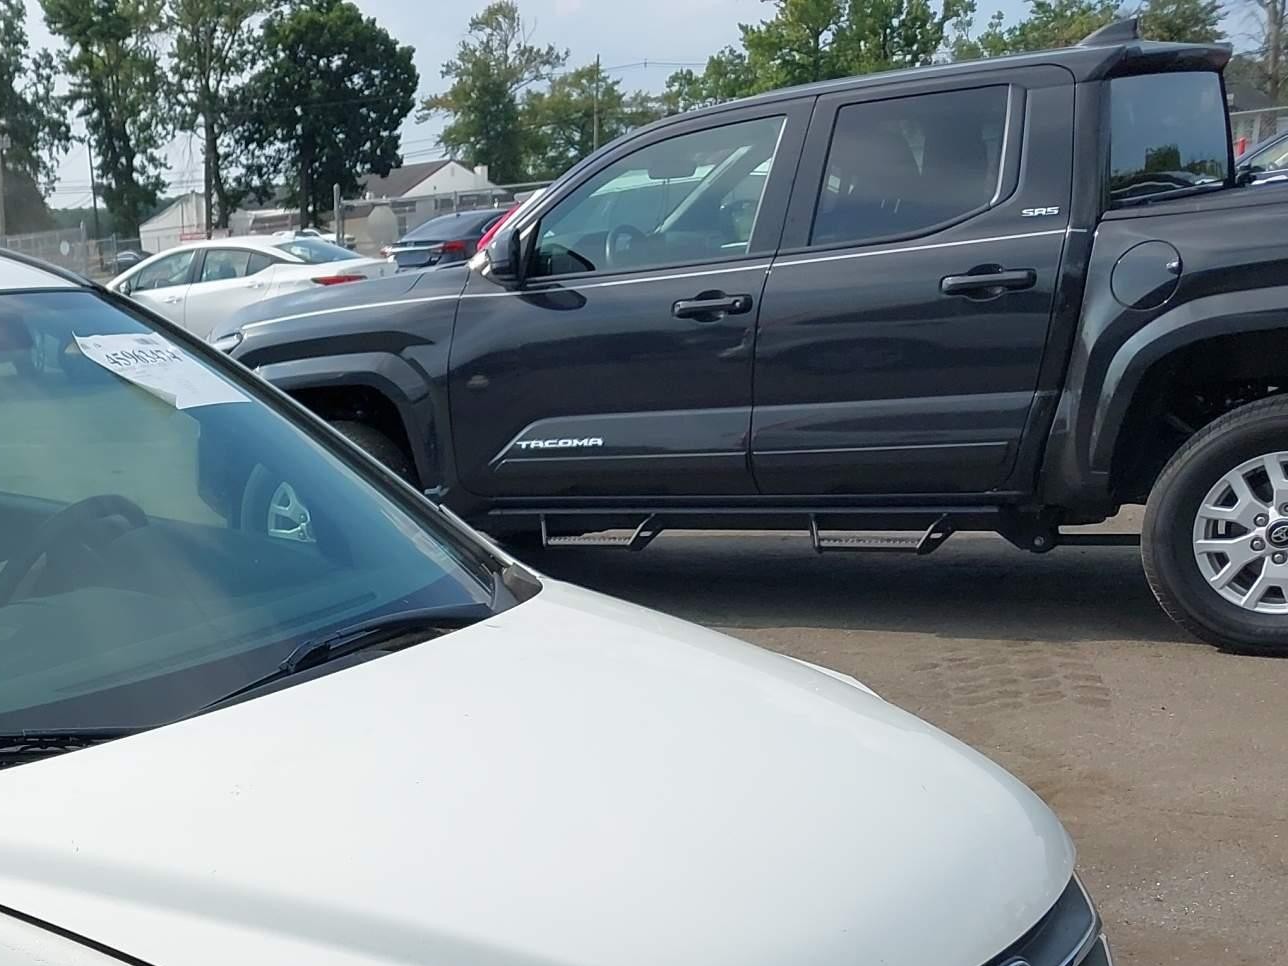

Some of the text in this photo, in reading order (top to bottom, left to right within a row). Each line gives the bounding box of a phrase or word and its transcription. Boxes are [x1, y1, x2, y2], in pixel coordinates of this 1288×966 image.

[1021, 206, 1060, 217] SR5
[105, 348, 185, 368] 45963474
[516, 437, 604, 449] TACOMA
